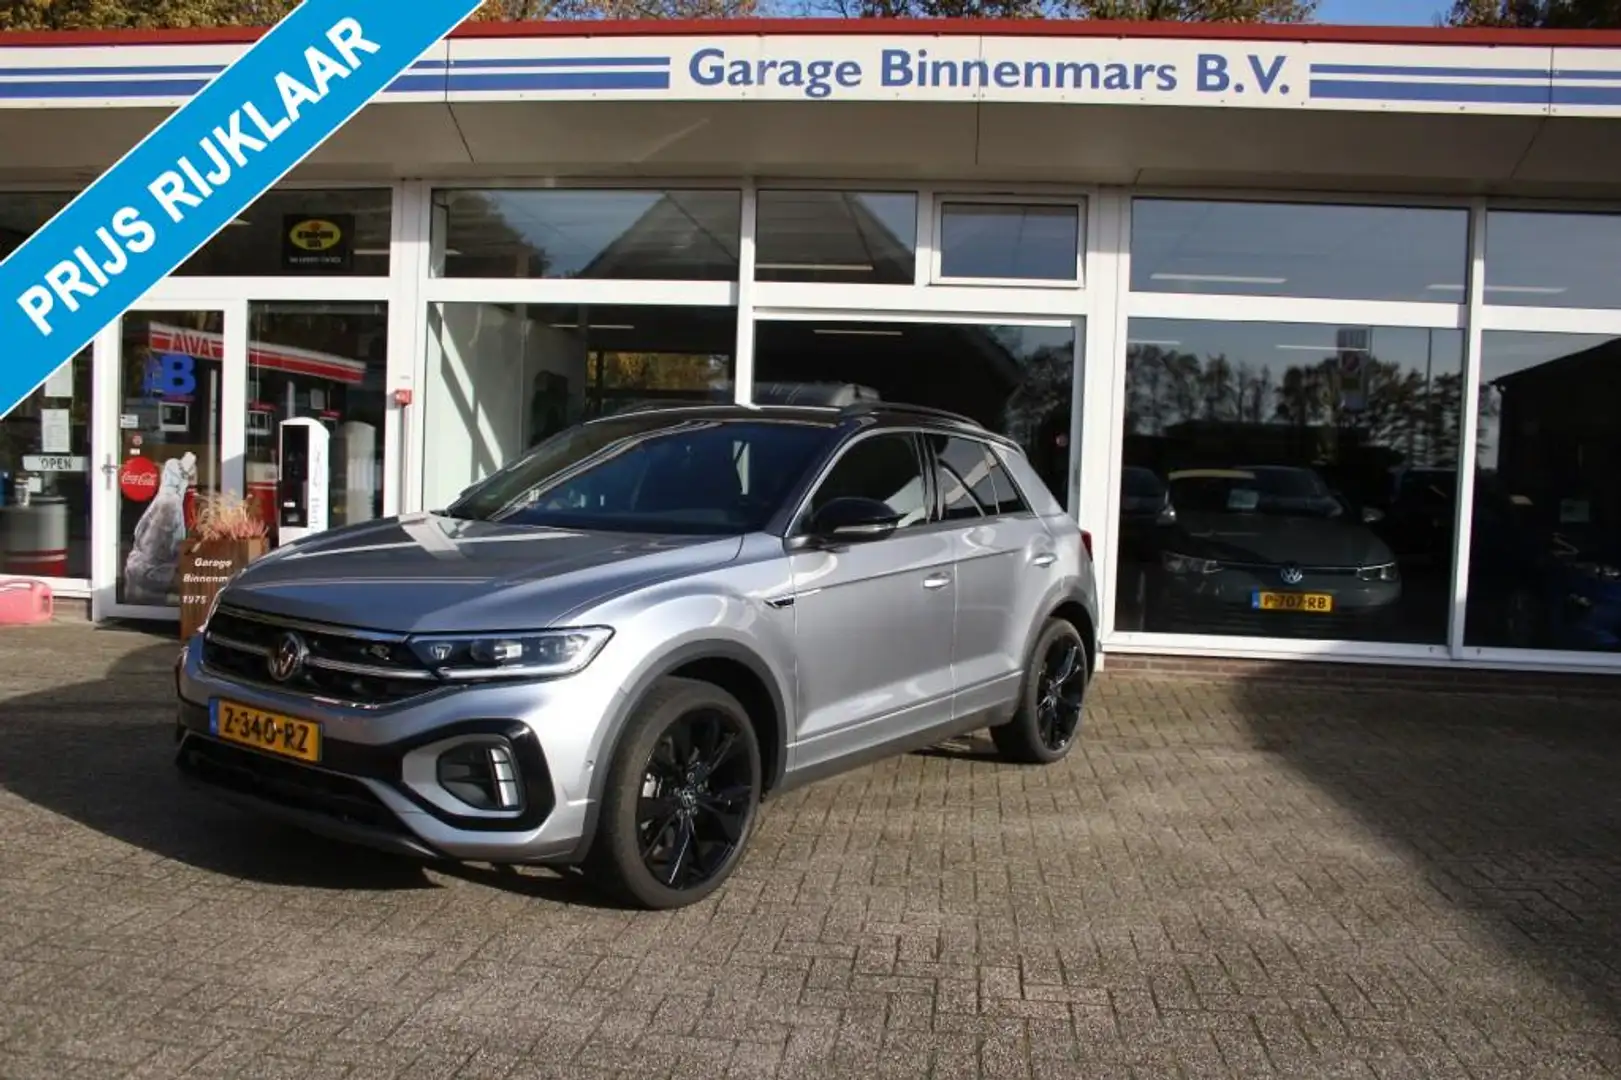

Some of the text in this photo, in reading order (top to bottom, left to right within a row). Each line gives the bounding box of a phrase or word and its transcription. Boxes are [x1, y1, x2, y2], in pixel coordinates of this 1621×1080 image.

[689, 48, 1290, 97] Garage Binnenmars B.V.
[40, 457, 72, 469] OPEN
[194, 557, 232, 569] Garage
[1263, 594, 1326, 610] P-707-RB
[223, 705, 310, 754] Z-340-RZ
